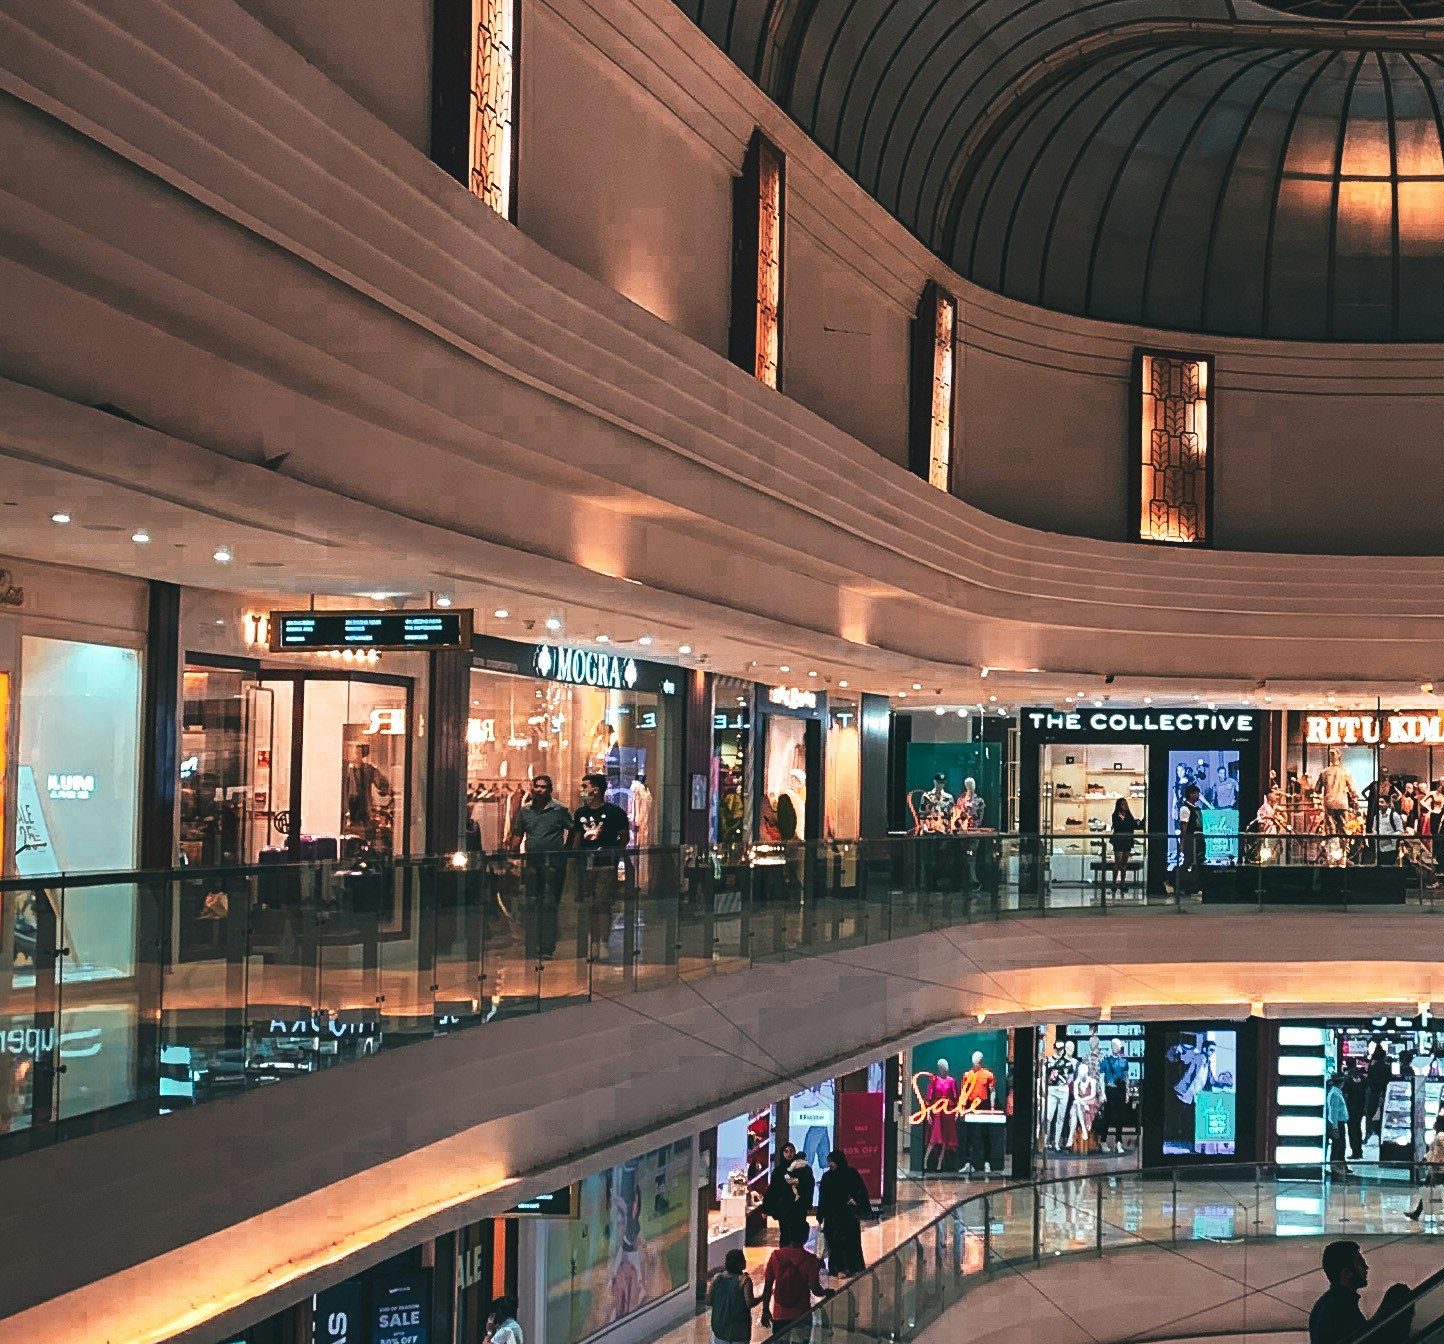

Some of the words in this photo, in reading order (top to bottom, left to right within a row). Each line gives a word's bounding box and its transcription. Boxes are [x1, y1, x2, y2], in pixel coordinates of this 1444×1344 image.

[556, 646, 621, 688] MOGRA
[1029, 713, 1081, 730] THE
[1090, 714, 1253, 731] COLLECTIVE
[1306, 715, 1379, 744] RITU
[909, 1072, 982, 1124] Sale
[457, 1245, 482, 1290] ALE
[379, 1311, 420, 1328] SALE
[401, 1336, 418, 1344] OFF
